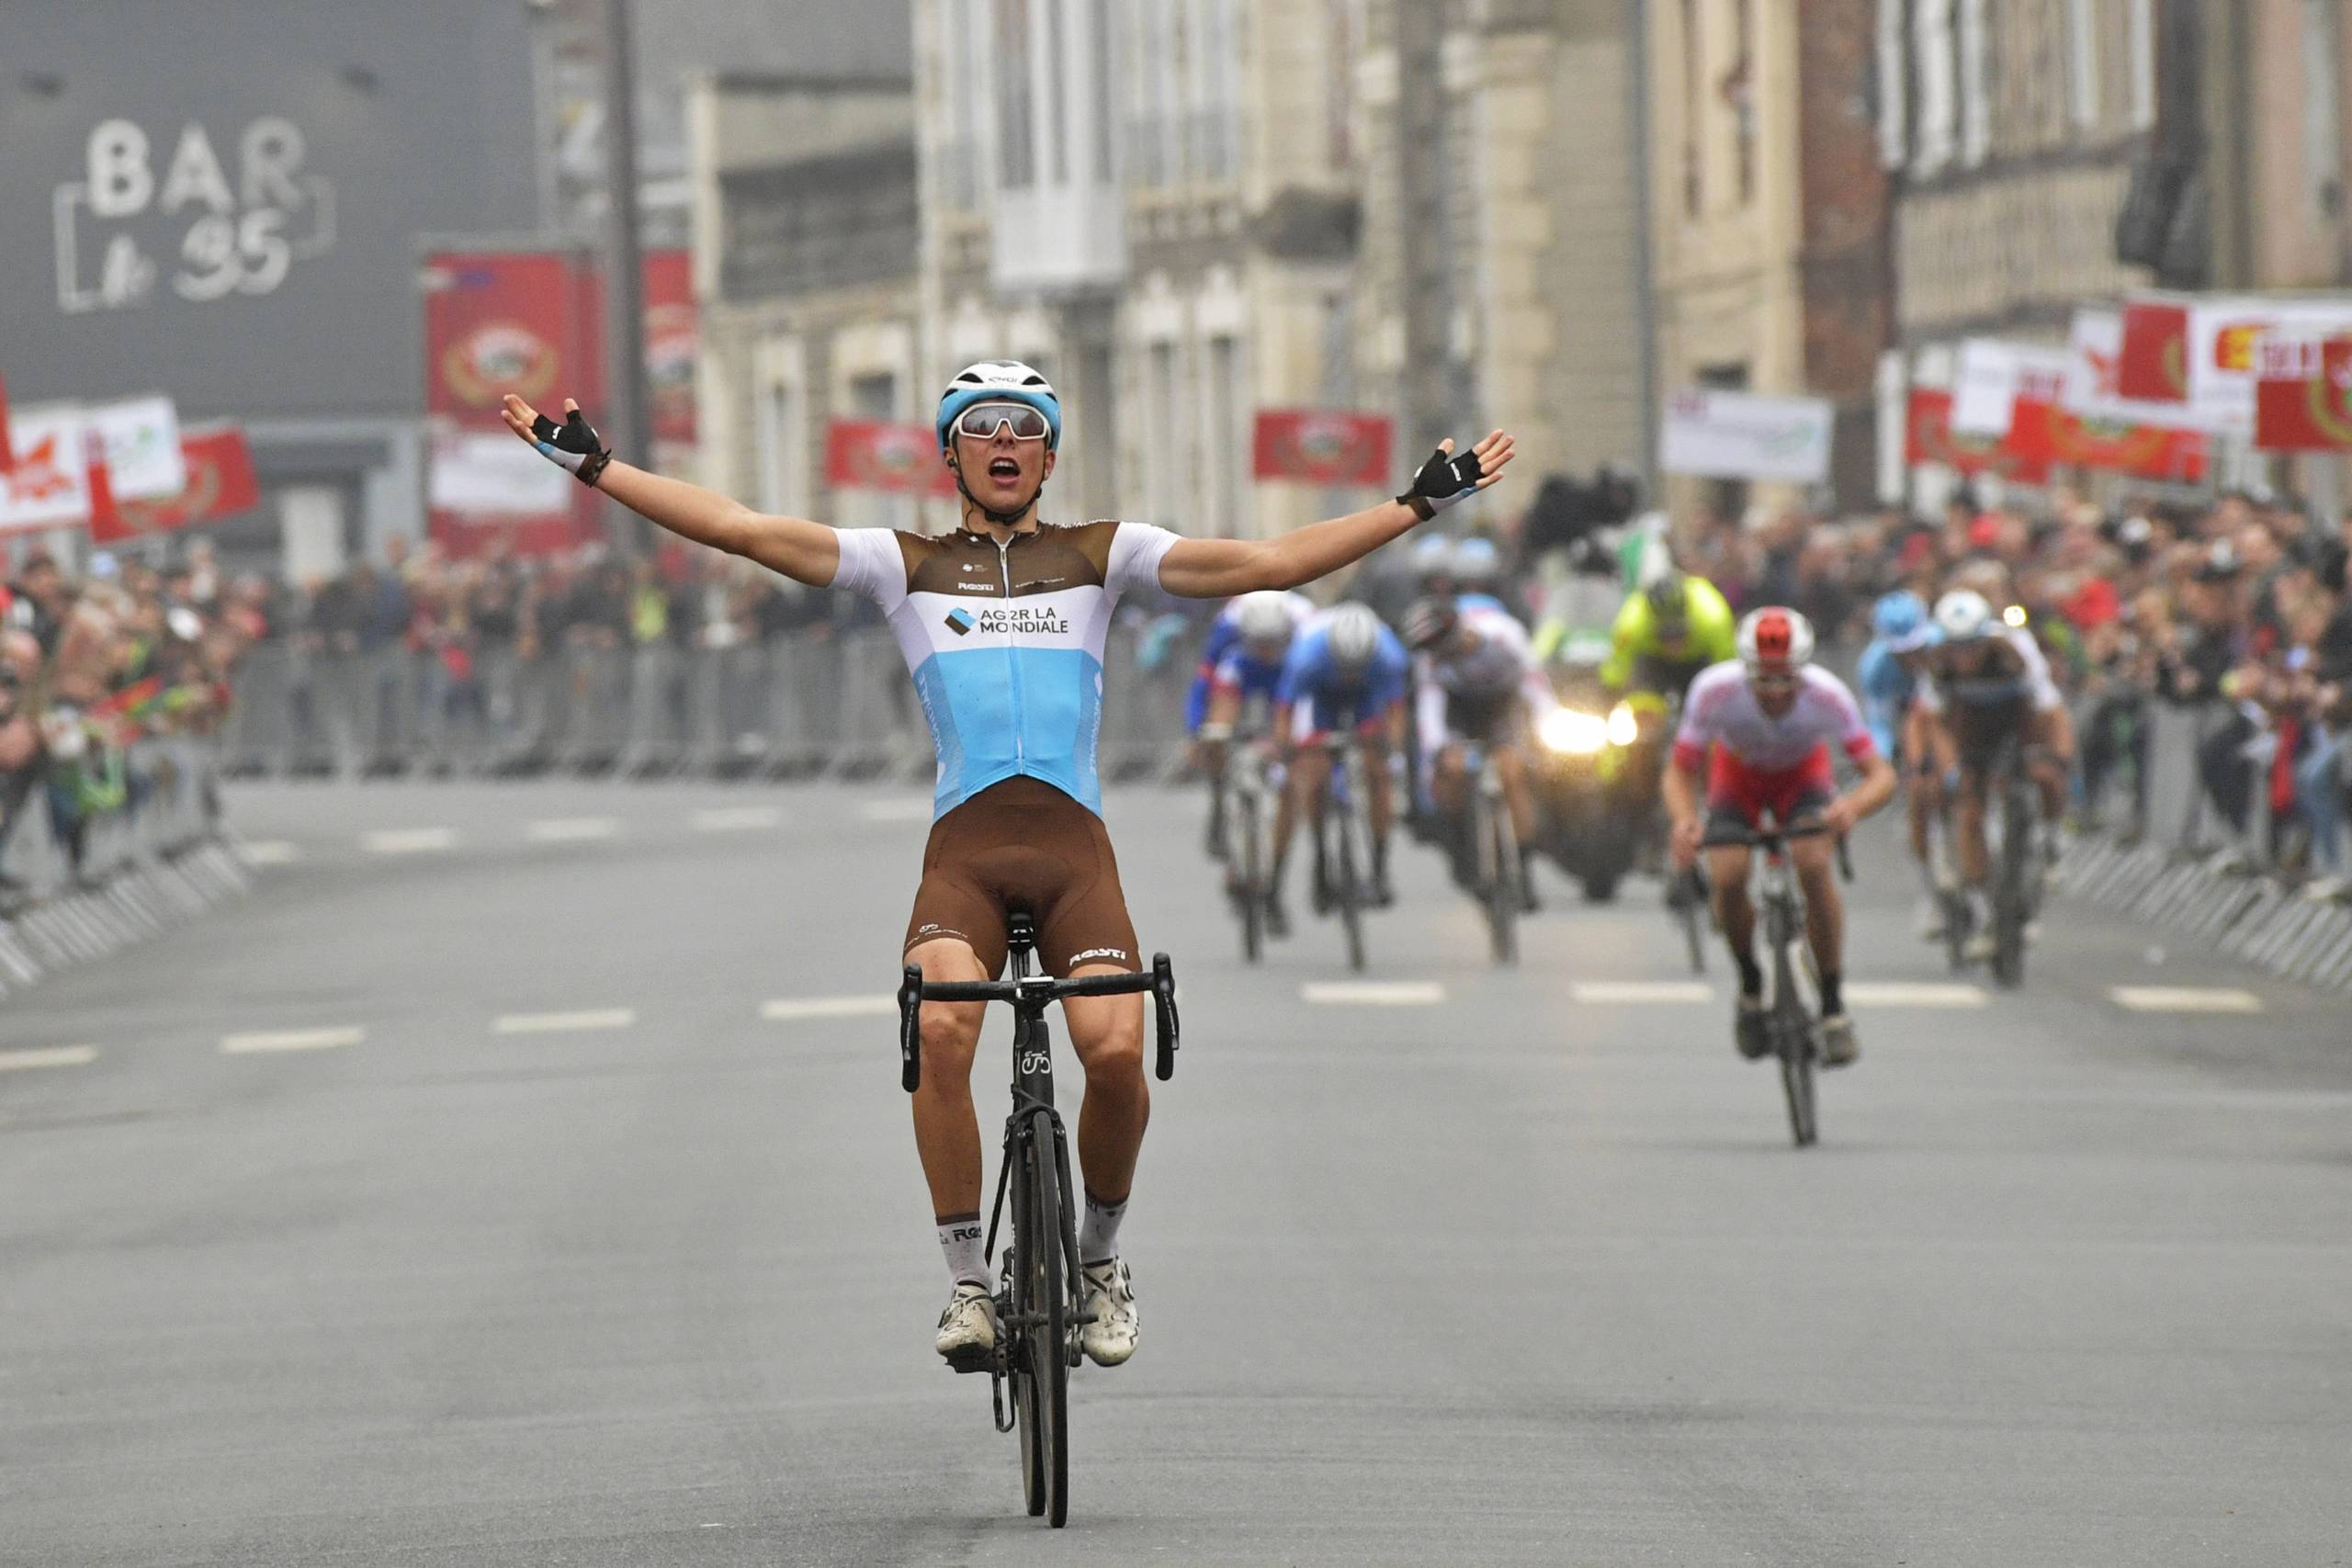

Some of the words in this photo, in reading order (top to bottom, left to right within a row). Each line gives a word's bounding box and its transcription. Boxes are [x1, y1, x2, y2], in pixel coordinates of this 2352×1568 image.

[87, 118, 305, 217] BAR
[172, 209, 290, 301] 95
[979, 620, 1069, 634] MONDIALE
[980, 609, 1030, 621] AG2R
[1035, 606, 1057, 619] LA
